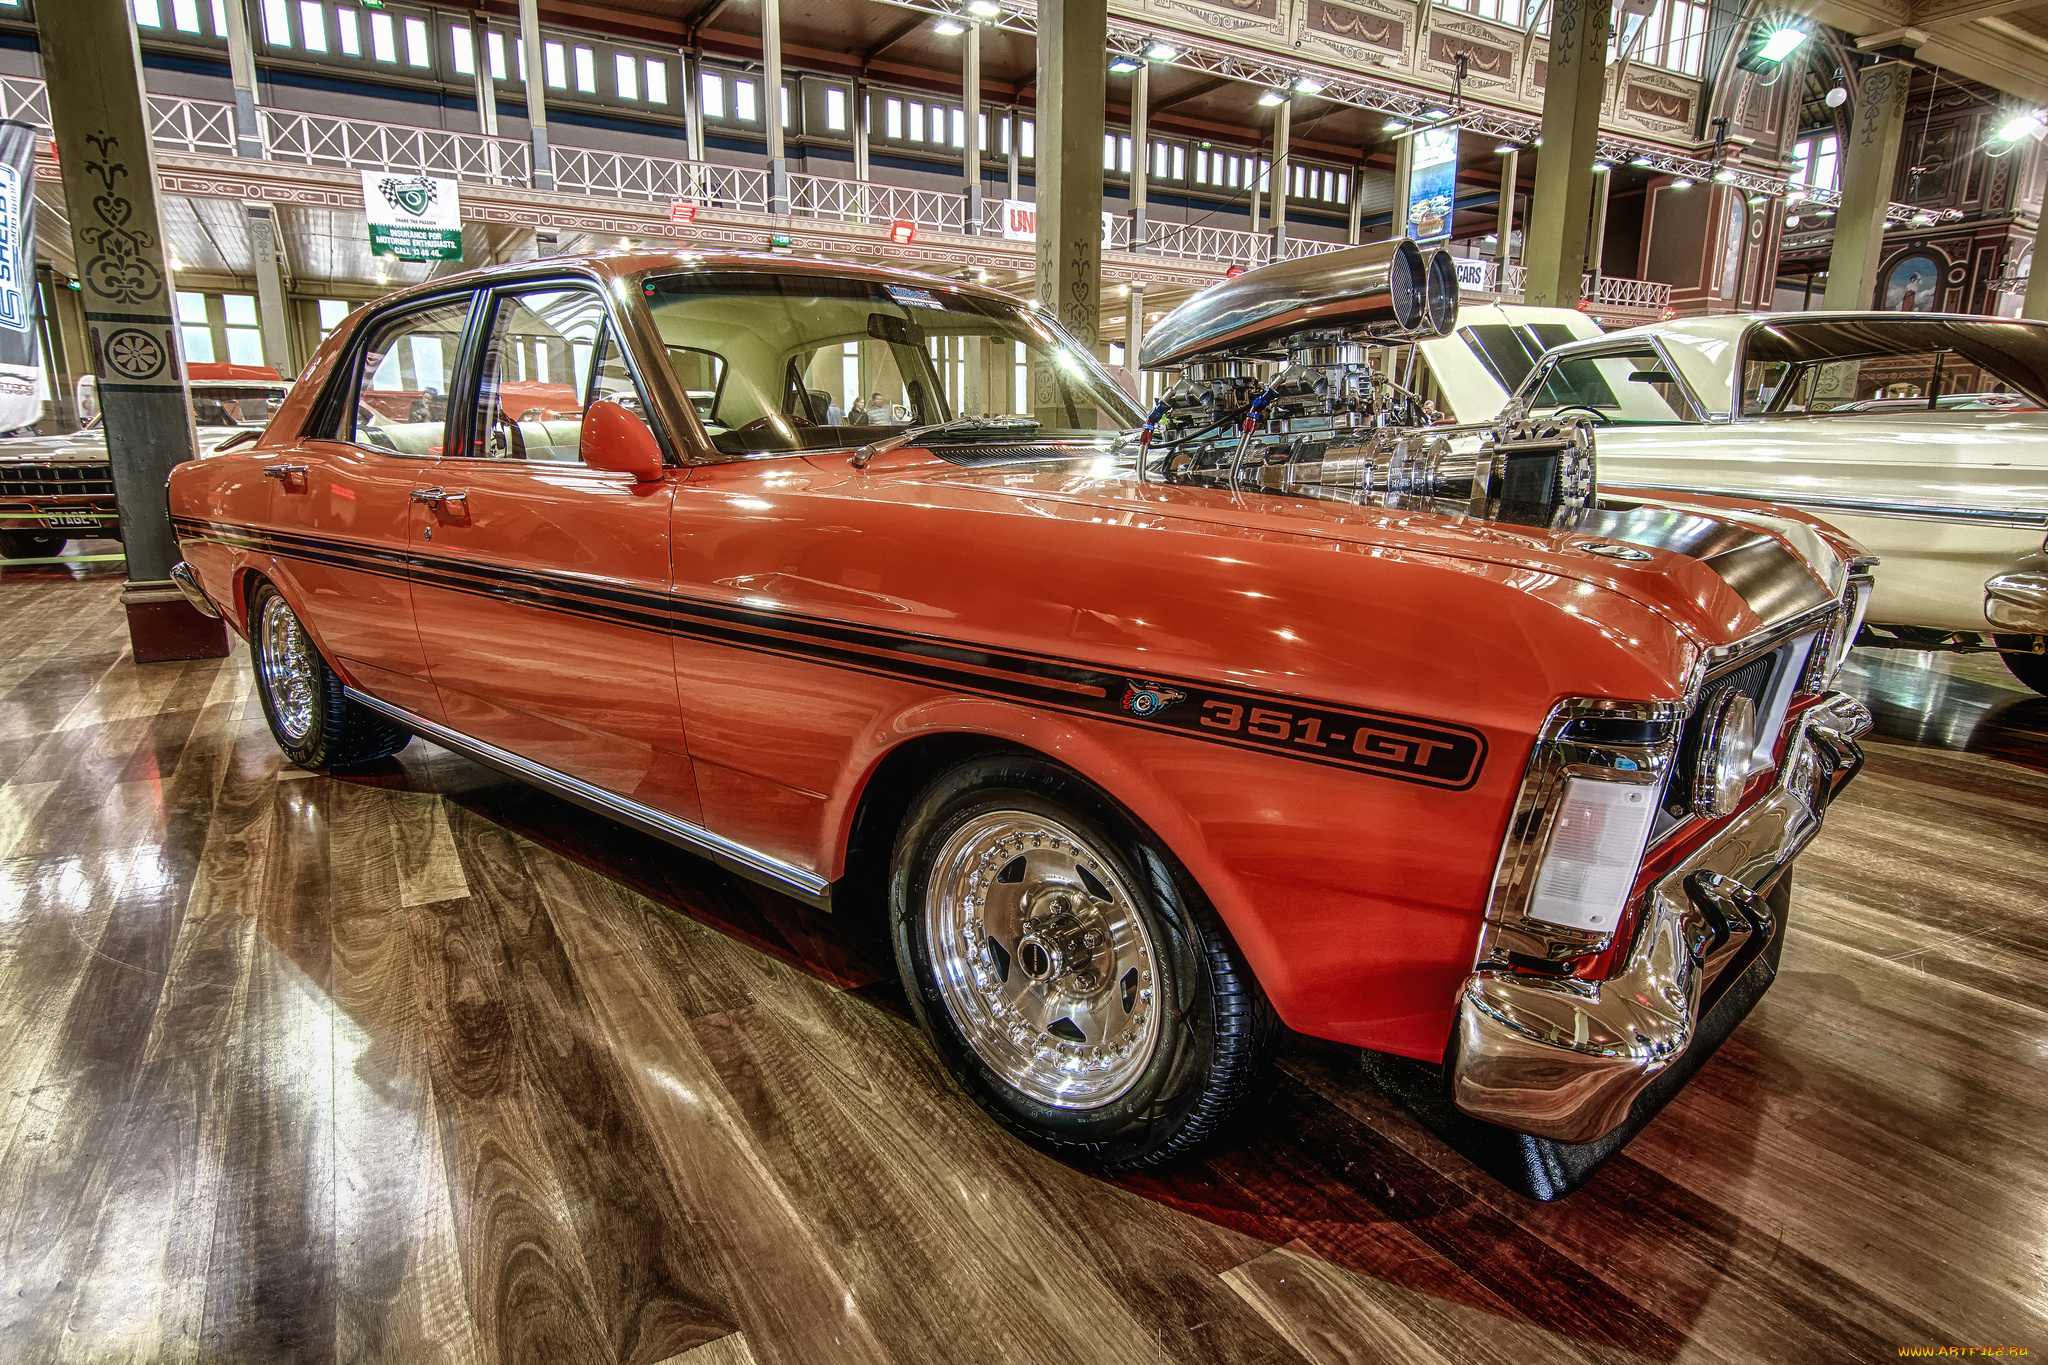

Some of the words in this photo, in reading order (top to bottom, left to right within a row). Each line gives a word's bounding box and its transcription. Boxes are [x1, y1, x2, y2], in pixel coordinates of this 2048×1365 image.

[390, 229, 427, 239] INSURANCE
[429, 232, 441, 240] FOR
[376, 236, 410, 246] MOTORING
[395, 247, 411, 255] CALL
[1457, 265, 1481, 284] CARS
[1199, 699, 1454, 766] 351-GT
